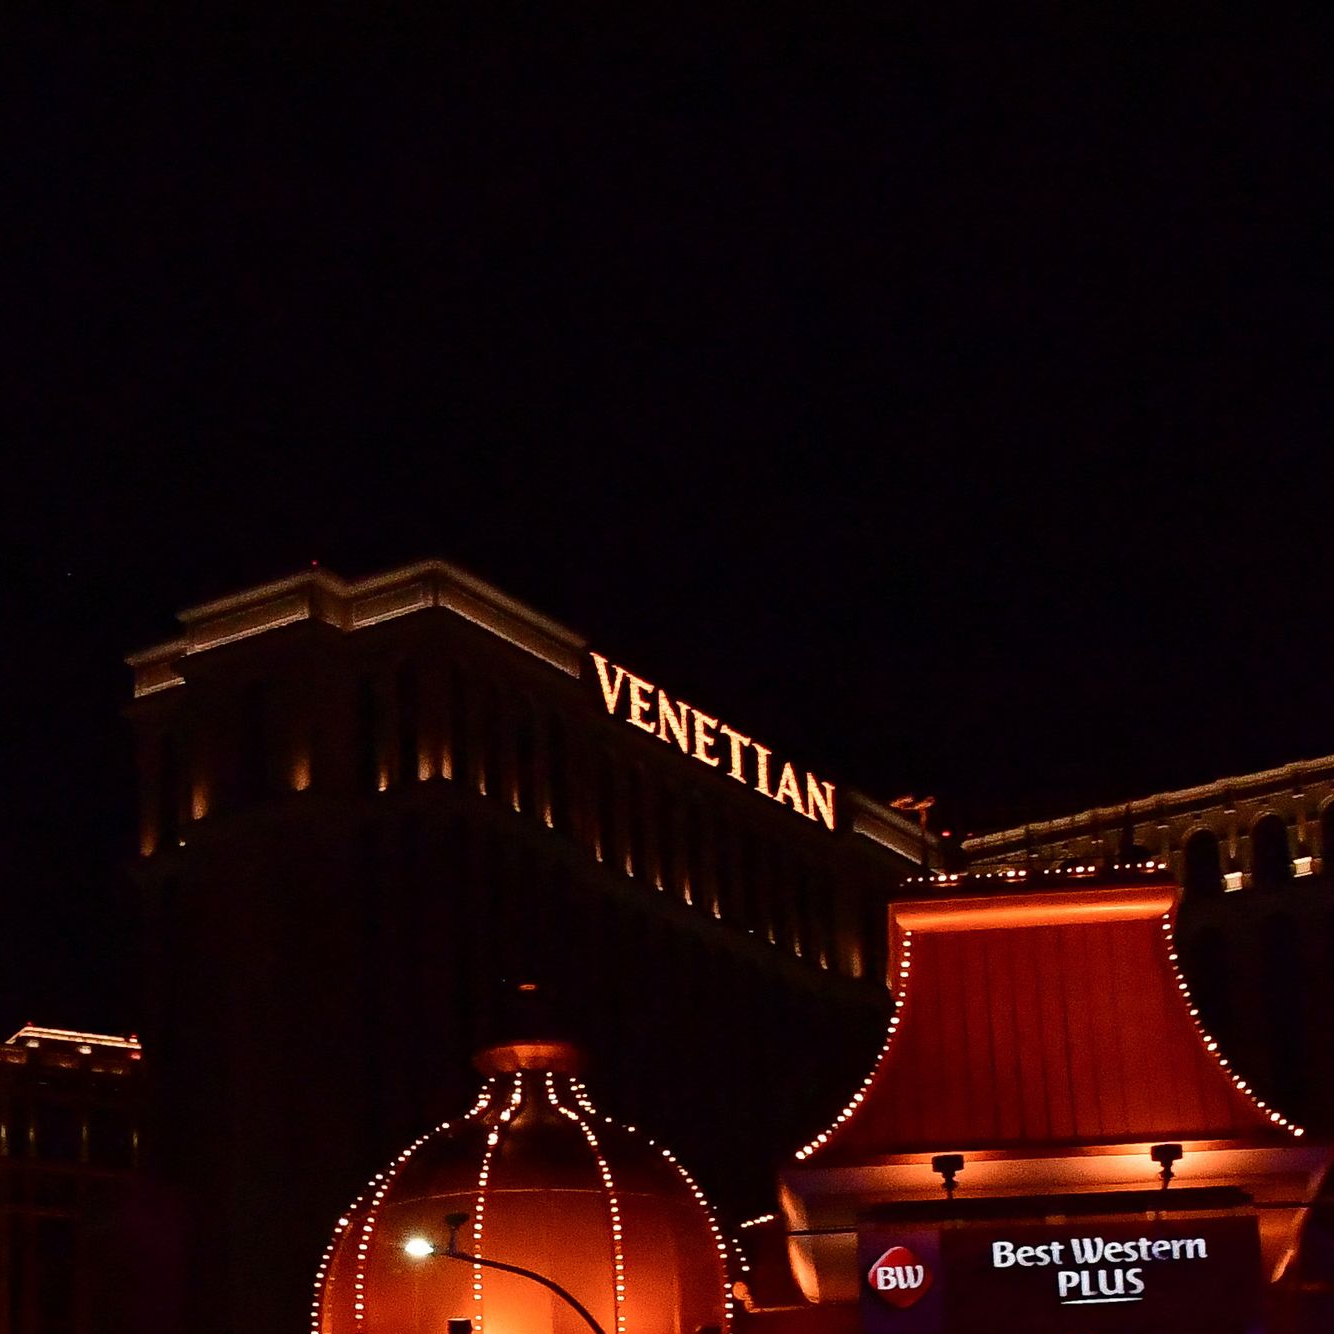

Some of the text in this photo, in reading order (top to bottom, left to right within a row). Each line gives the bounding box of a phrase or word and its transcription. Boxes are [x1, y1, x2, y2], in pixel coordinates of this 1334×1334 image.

[589, 651, 836, 833] VENETIAN
[992, 1237, 1208, 1268] Best Western
[876, 1264, 924, 1290] BW
[1057, 1267, 1145, 1297] PLUS
